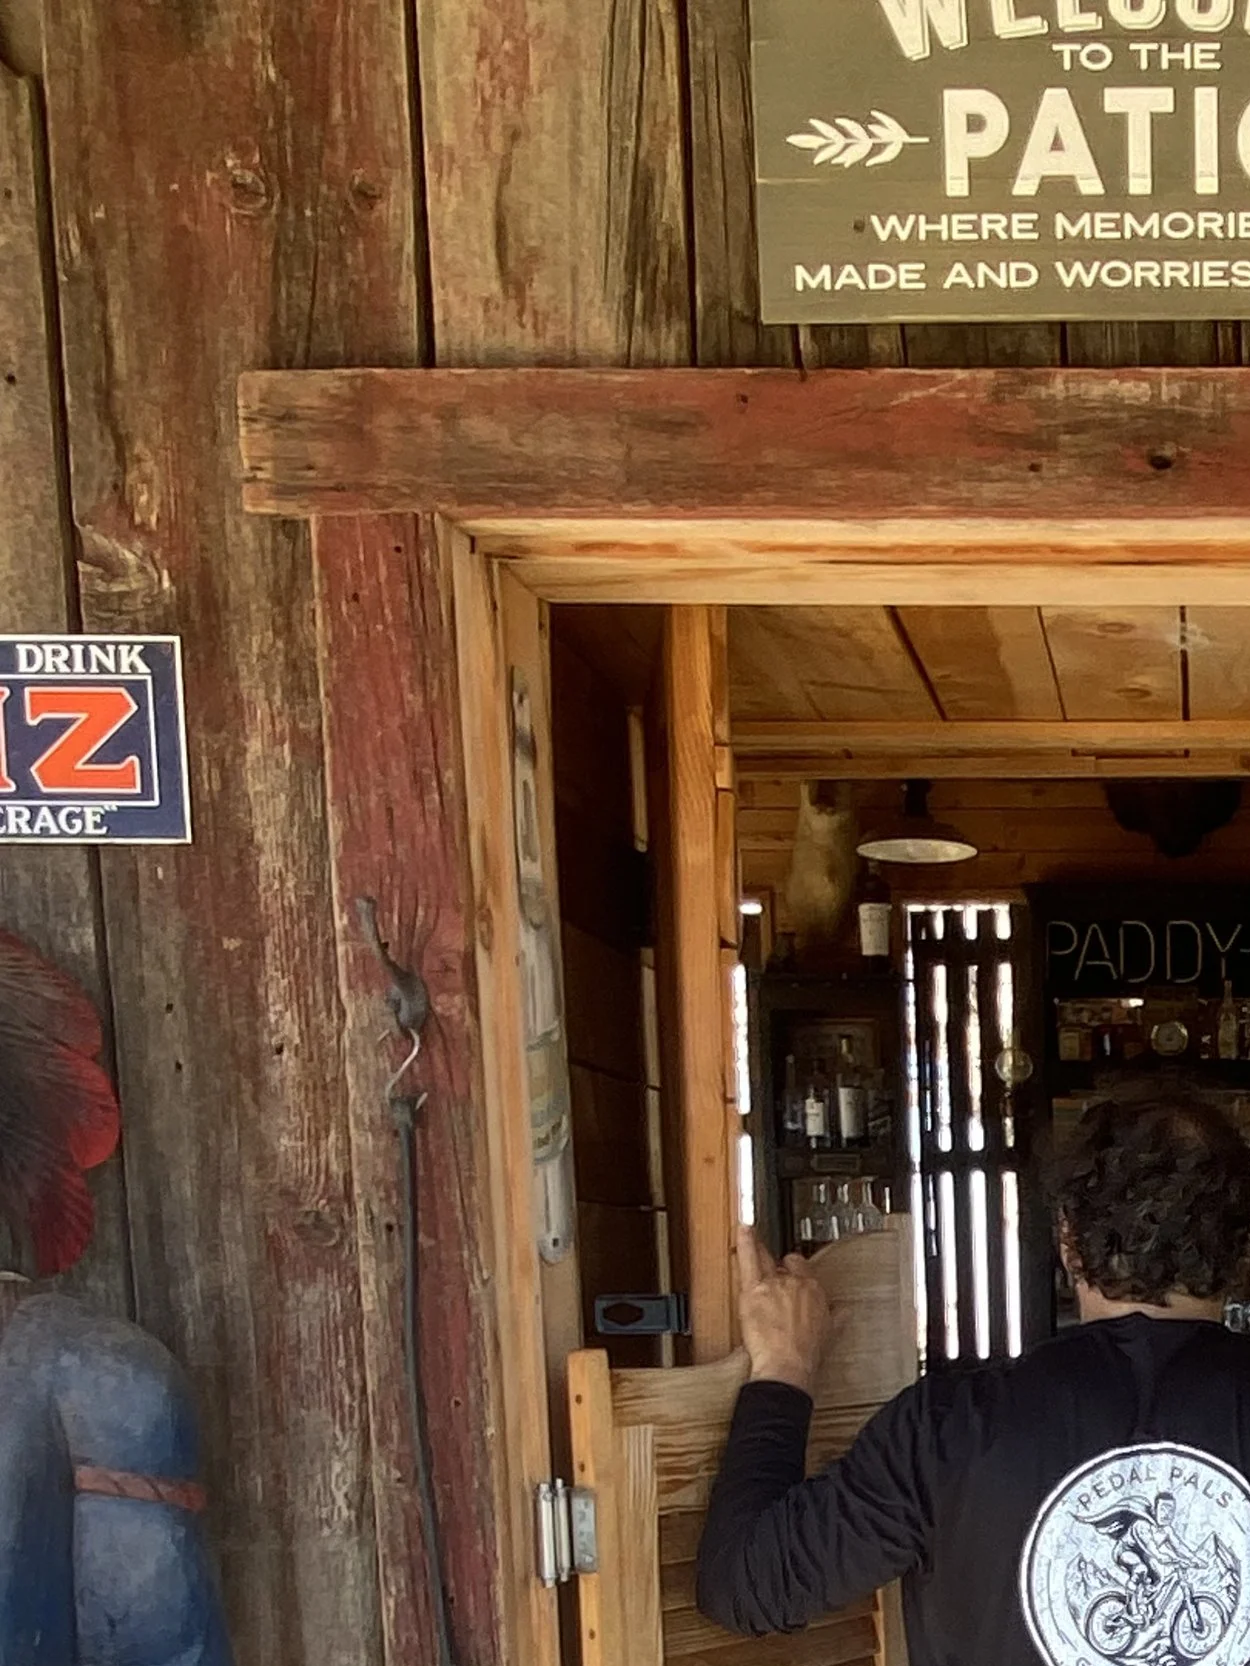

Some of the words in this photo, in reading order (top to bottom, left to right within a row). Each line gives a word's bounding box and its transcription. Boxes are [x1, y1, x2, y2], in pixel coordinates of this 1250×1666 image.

[1051, 43, 1115, 71] TO
[1128, 42, 1222, 71] THE
[870, 211, 1039, 243] WHERE
[794, 262, 927, 292] MADE
[942, 261, 1039, 291] AND
[16, 643, 151, 674] DRINK
[1077, 1467, 1157, 1512] PEDAL
[1169, 1466, 1234, 1509] PALS
